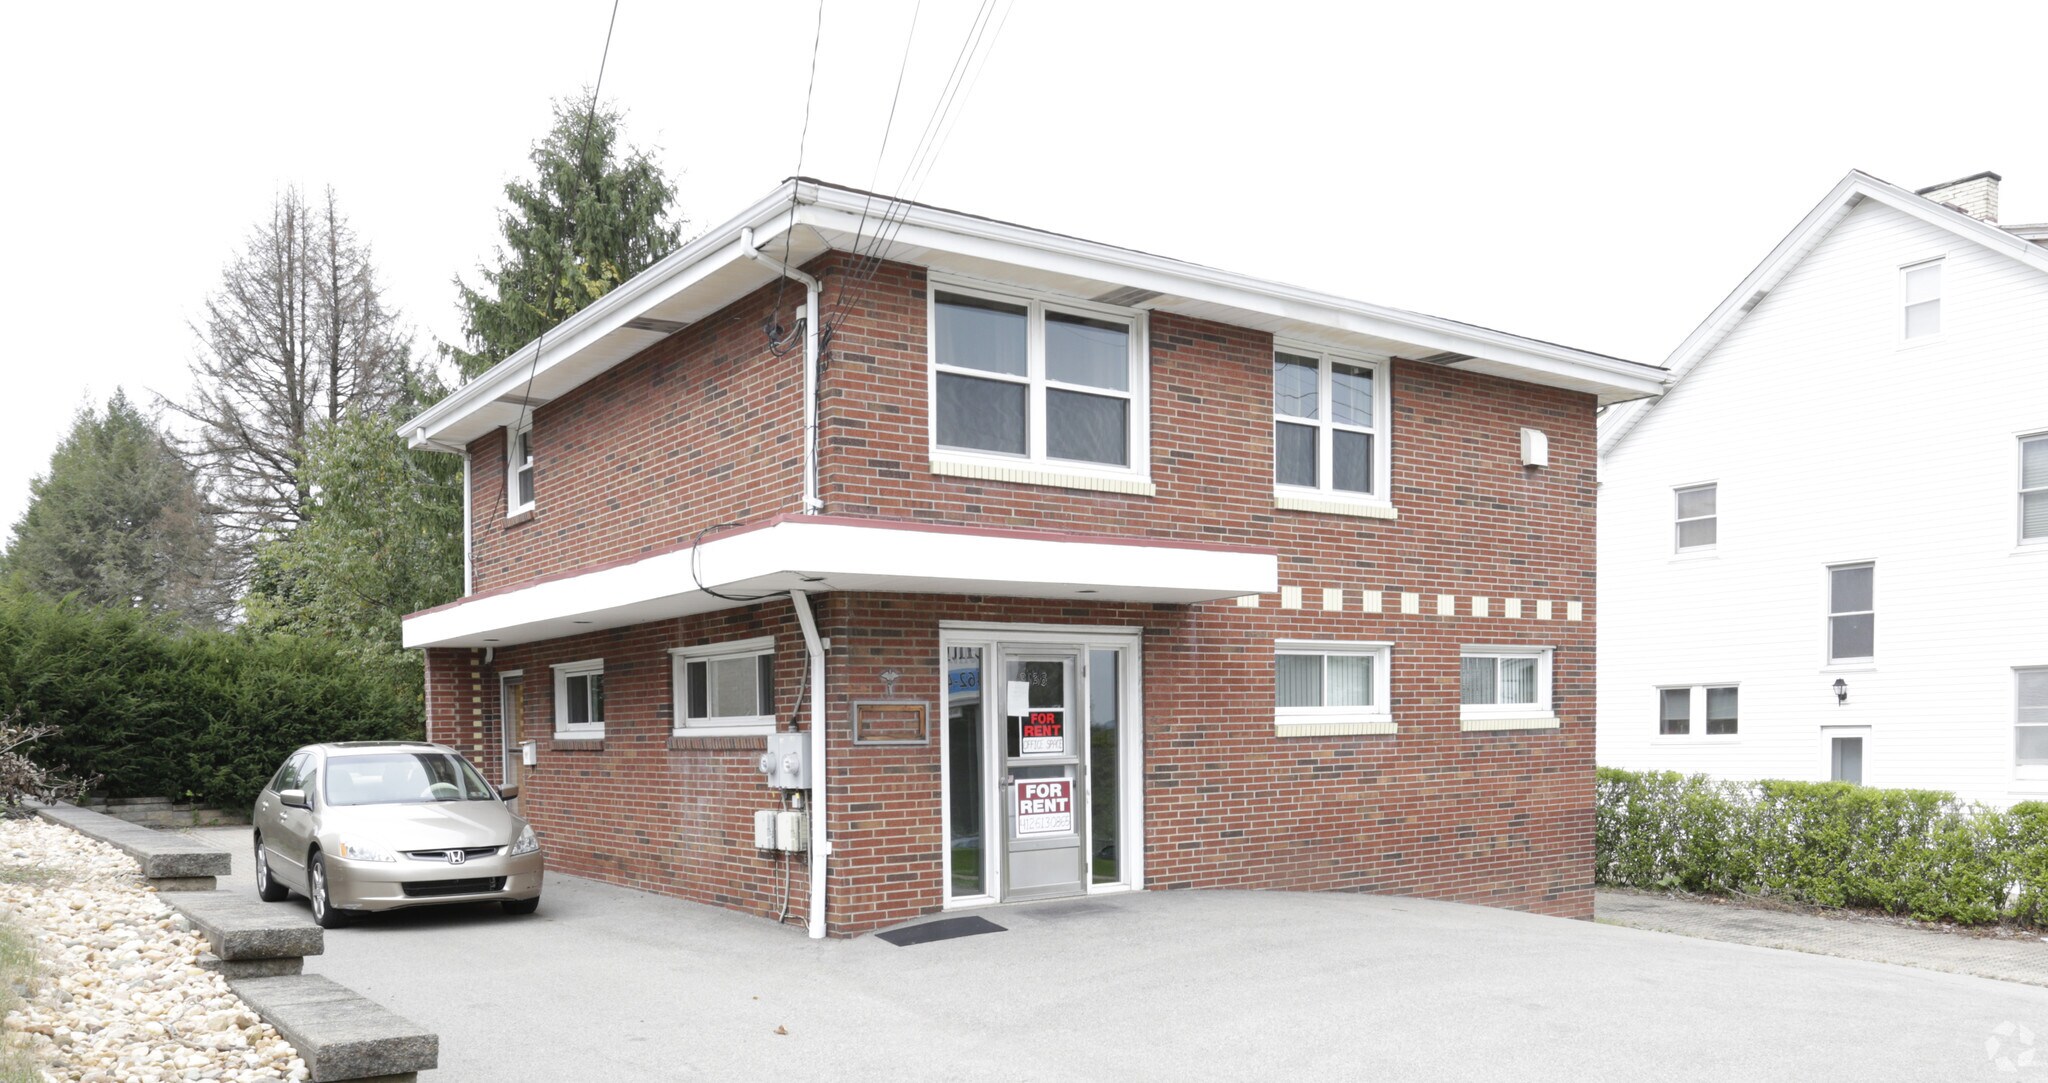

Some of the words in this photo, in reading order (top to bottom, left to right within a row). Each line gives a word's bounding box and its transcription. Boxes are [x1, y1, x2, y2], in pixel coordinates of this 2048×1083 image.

[1031, 713, 1055, 724] FOR
[1023, 725, 1061, 737] RENT
[1026, 783, 1062, 799] FOR
[1020, 798, 1068, 814] RENT
